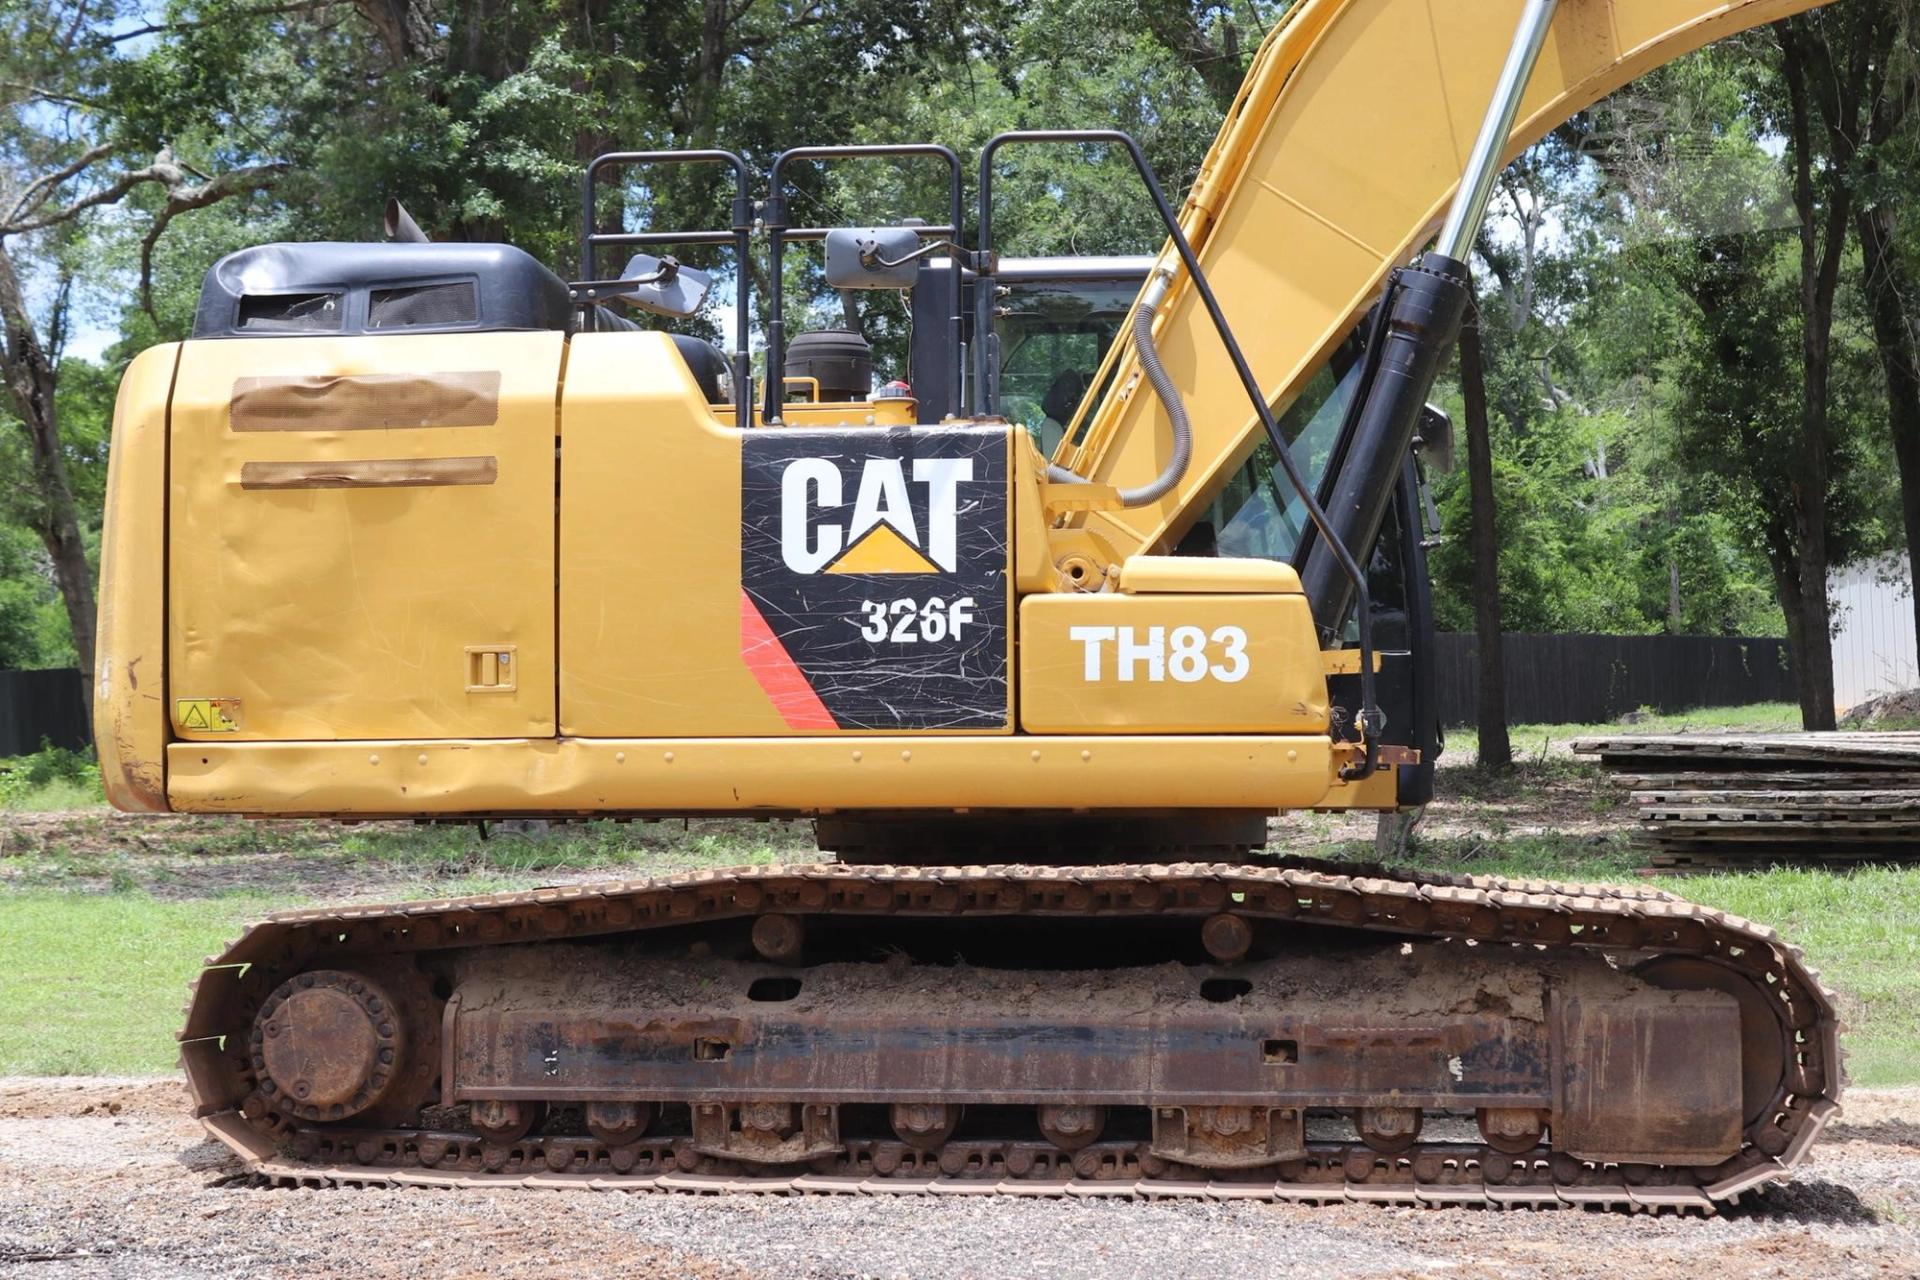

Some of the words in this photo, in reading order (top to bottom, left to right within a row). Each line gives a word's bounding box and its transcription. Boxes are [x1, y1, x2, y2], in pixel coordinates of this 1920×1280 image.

[781, 457, 974, 575] CAT
[861, 597, 974, 642] 326F
[1070, 626, 1250, 682] TH83
